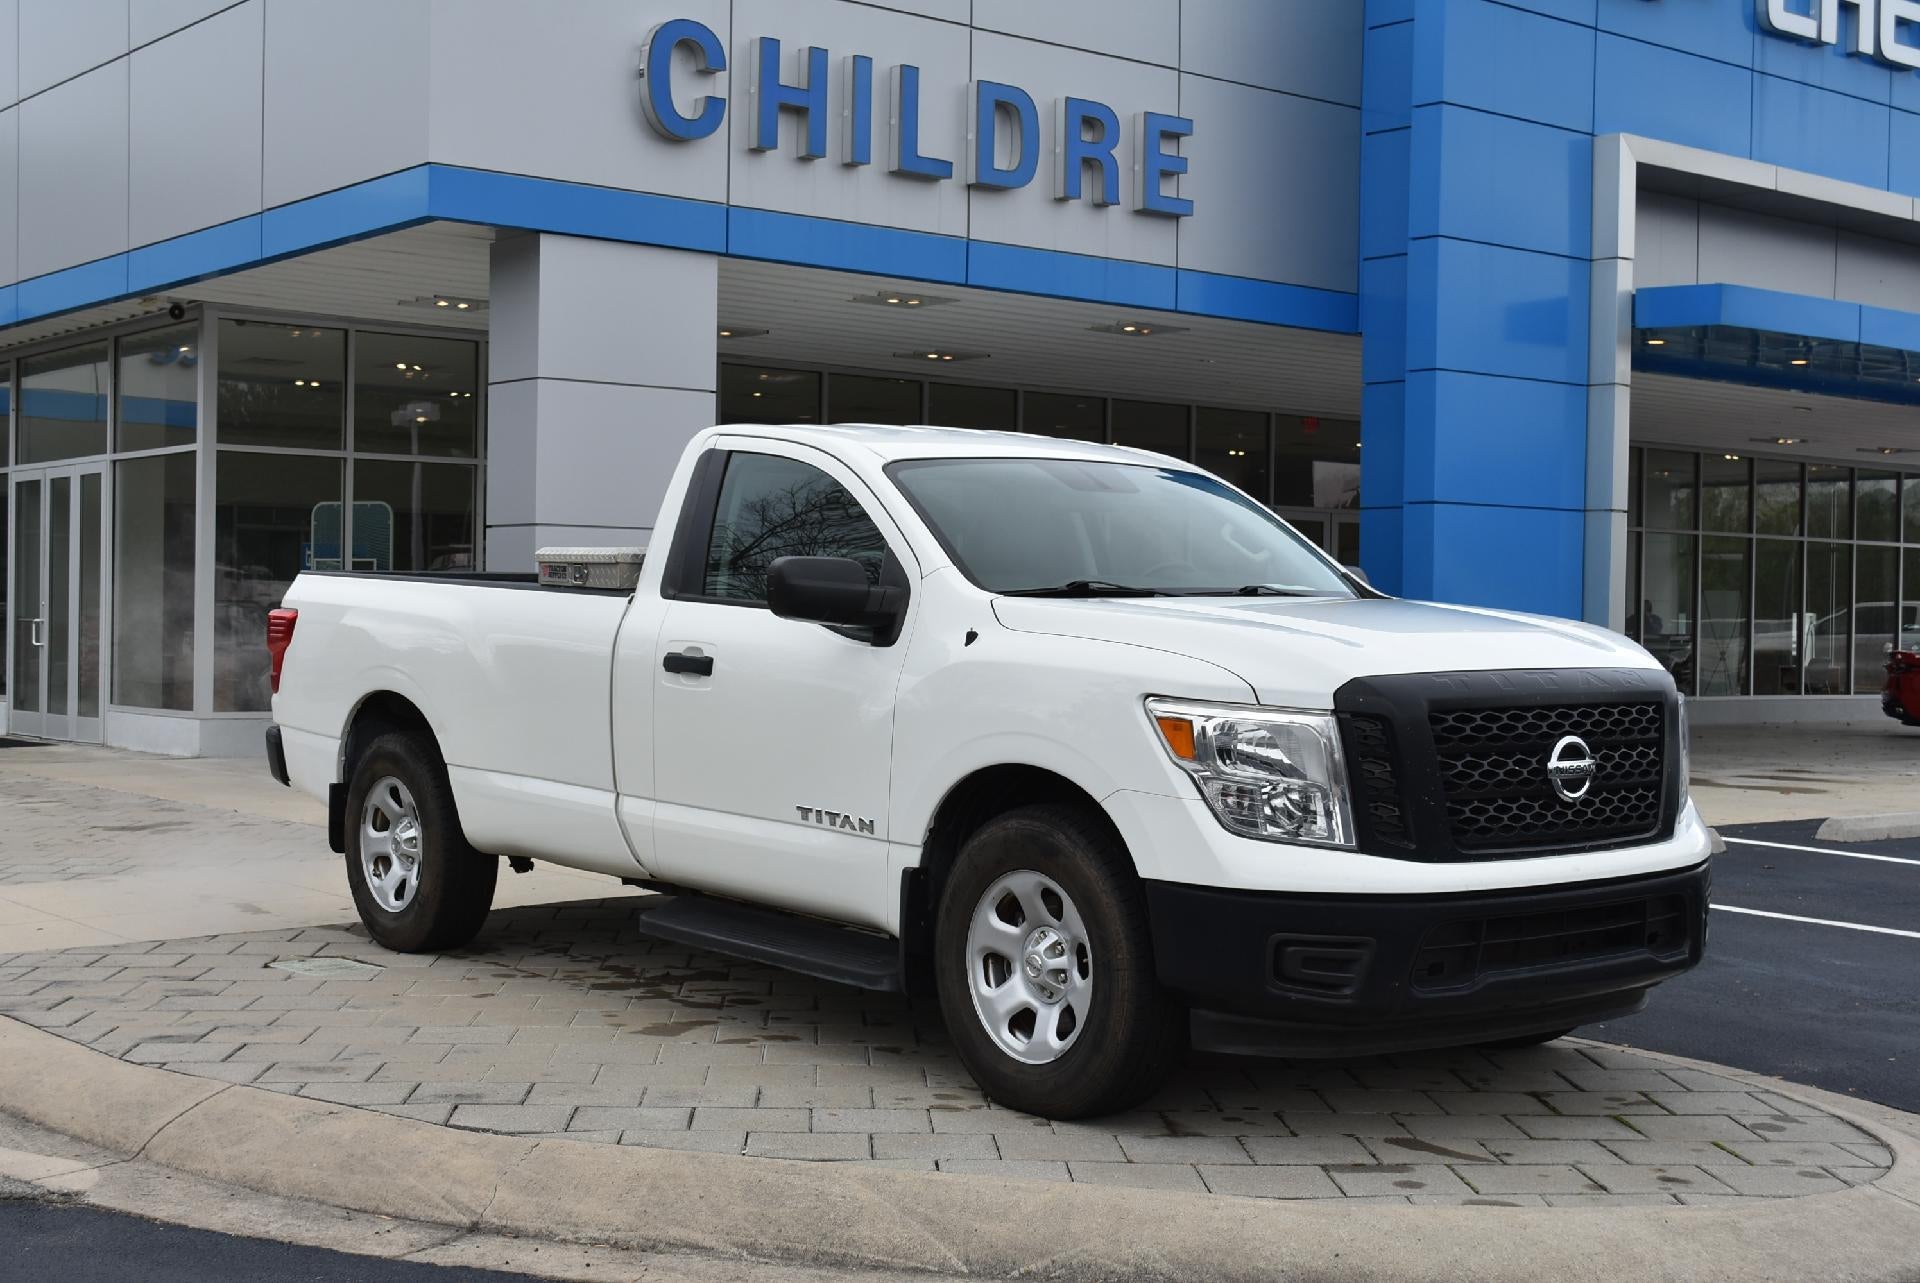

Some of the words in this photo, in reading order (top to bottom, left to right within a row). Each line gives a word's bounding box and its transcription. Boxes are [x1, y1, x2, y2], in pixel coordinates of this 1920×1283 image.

[641, 19, 1194, 217] CHILDRE
[1431, 669, 1648, 691] TITAN
[1553, 764, 1596, 775] NISSAN
[796, 805, 875, 835] TITAN
